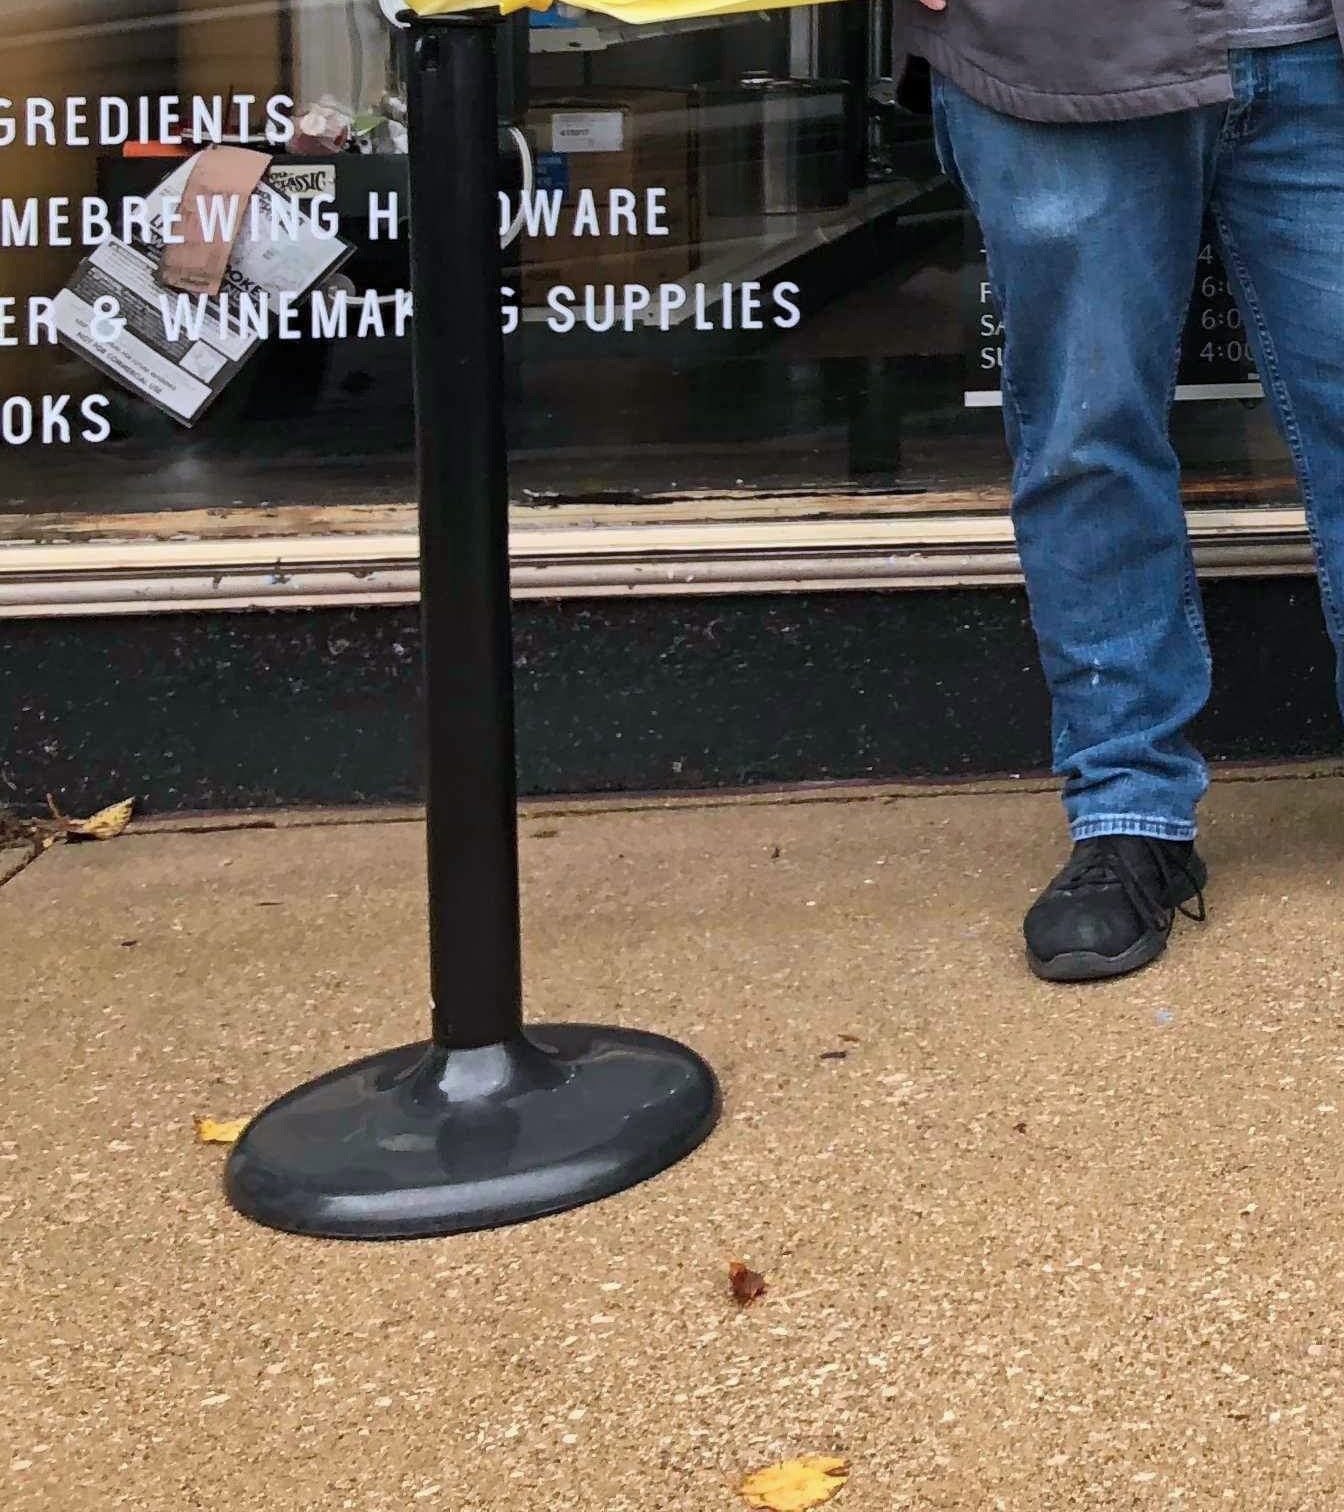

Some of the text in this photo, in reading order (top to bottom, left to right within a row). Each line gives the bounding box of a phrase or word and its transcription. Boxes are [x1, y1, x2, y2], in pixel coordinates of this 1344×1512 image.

[369, 187, 669, 240] HWARE
[91, 295, 128, 344] &
[158, 285, 519, 343] WINEMAKG
[546, 281, 802, 333] SUPPLIES
